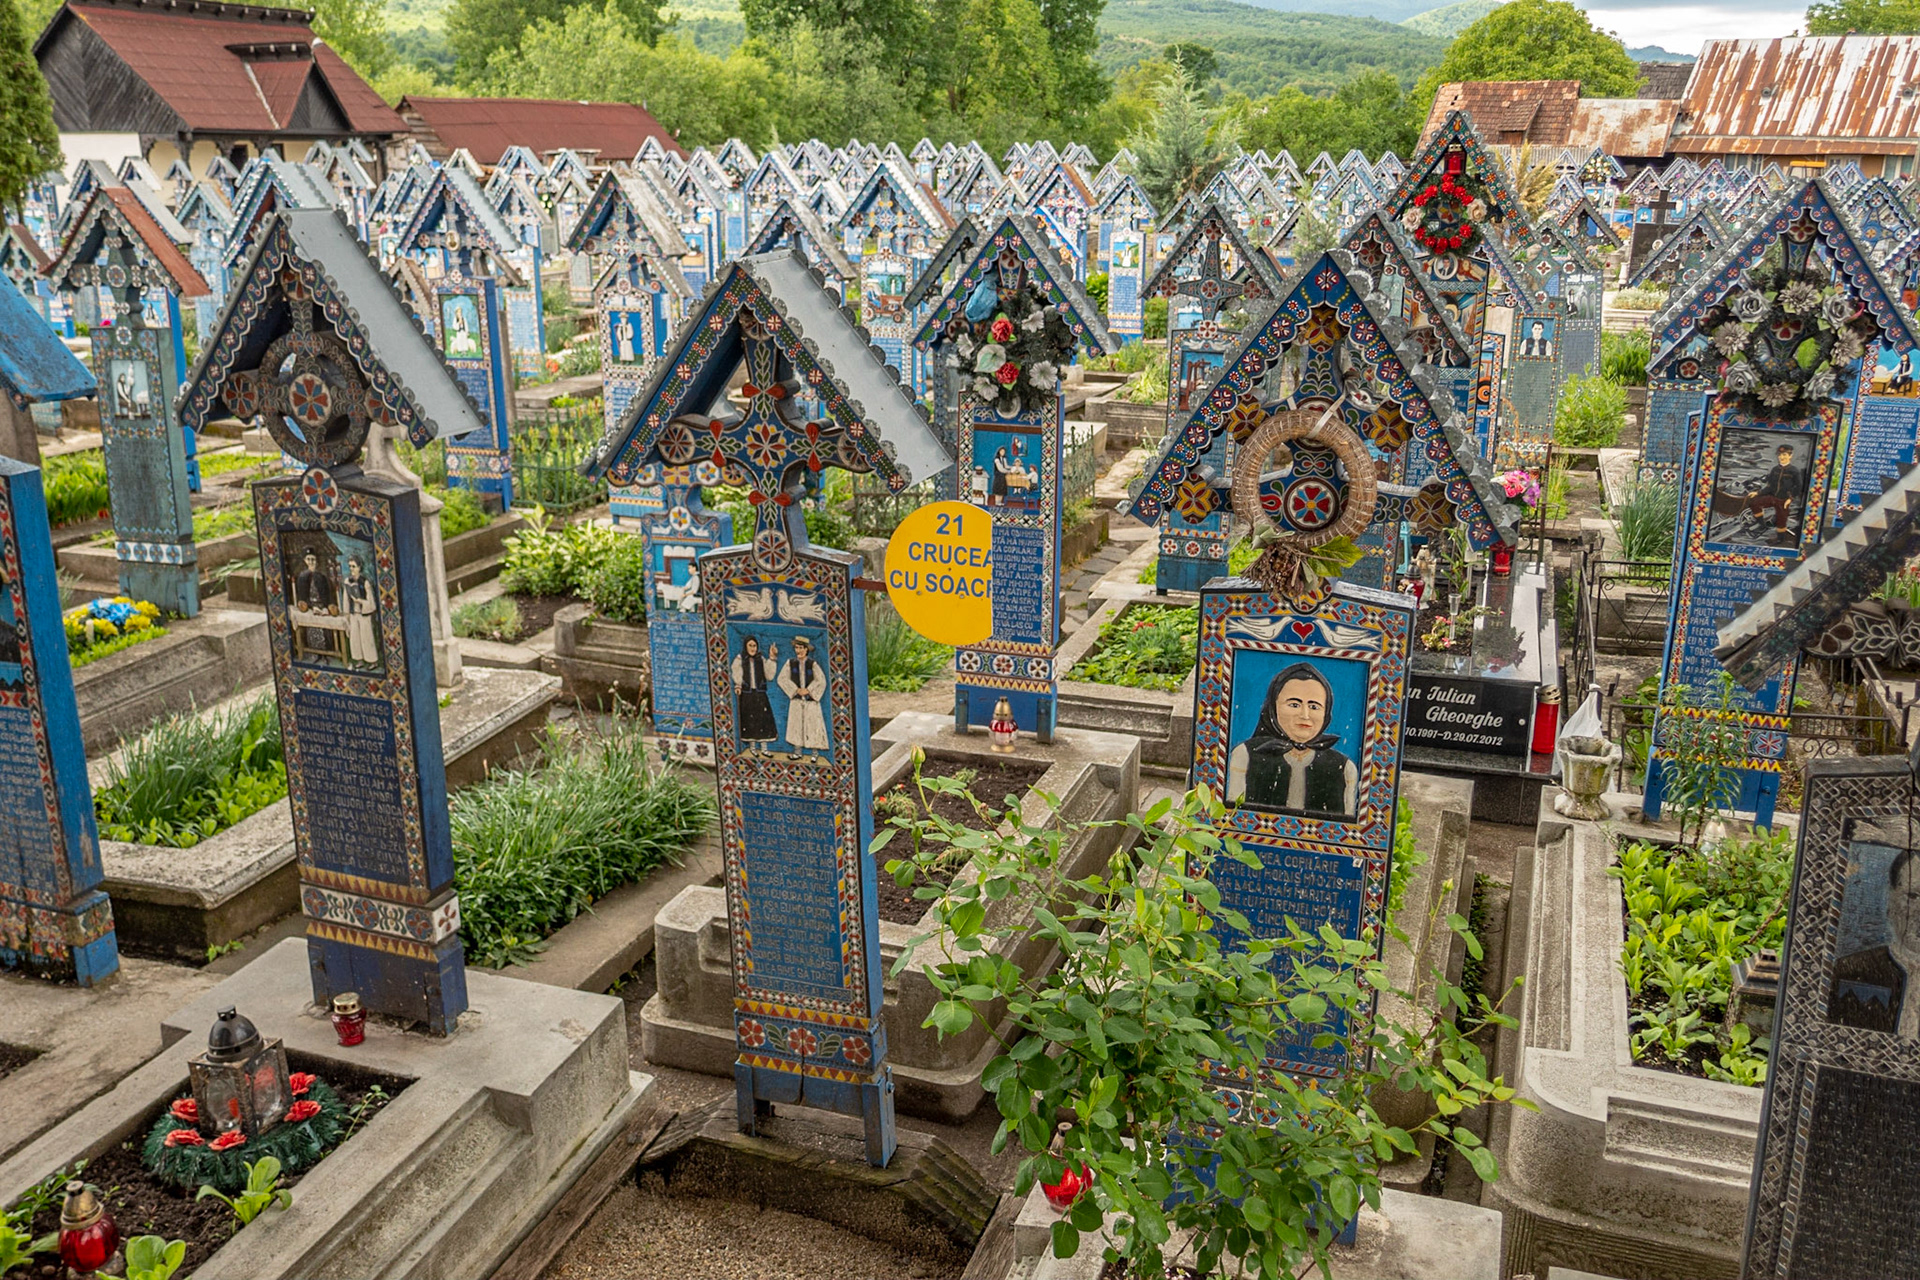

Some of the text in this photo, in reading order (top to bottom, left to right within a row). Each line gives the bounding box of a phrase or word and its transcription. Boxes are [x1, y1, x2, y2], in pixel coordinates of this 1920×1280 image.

[936, 513, 962, 536] 21
[890, 570, 918, 590] CU
[1426, 706, 1504, 730] Gheorghe
